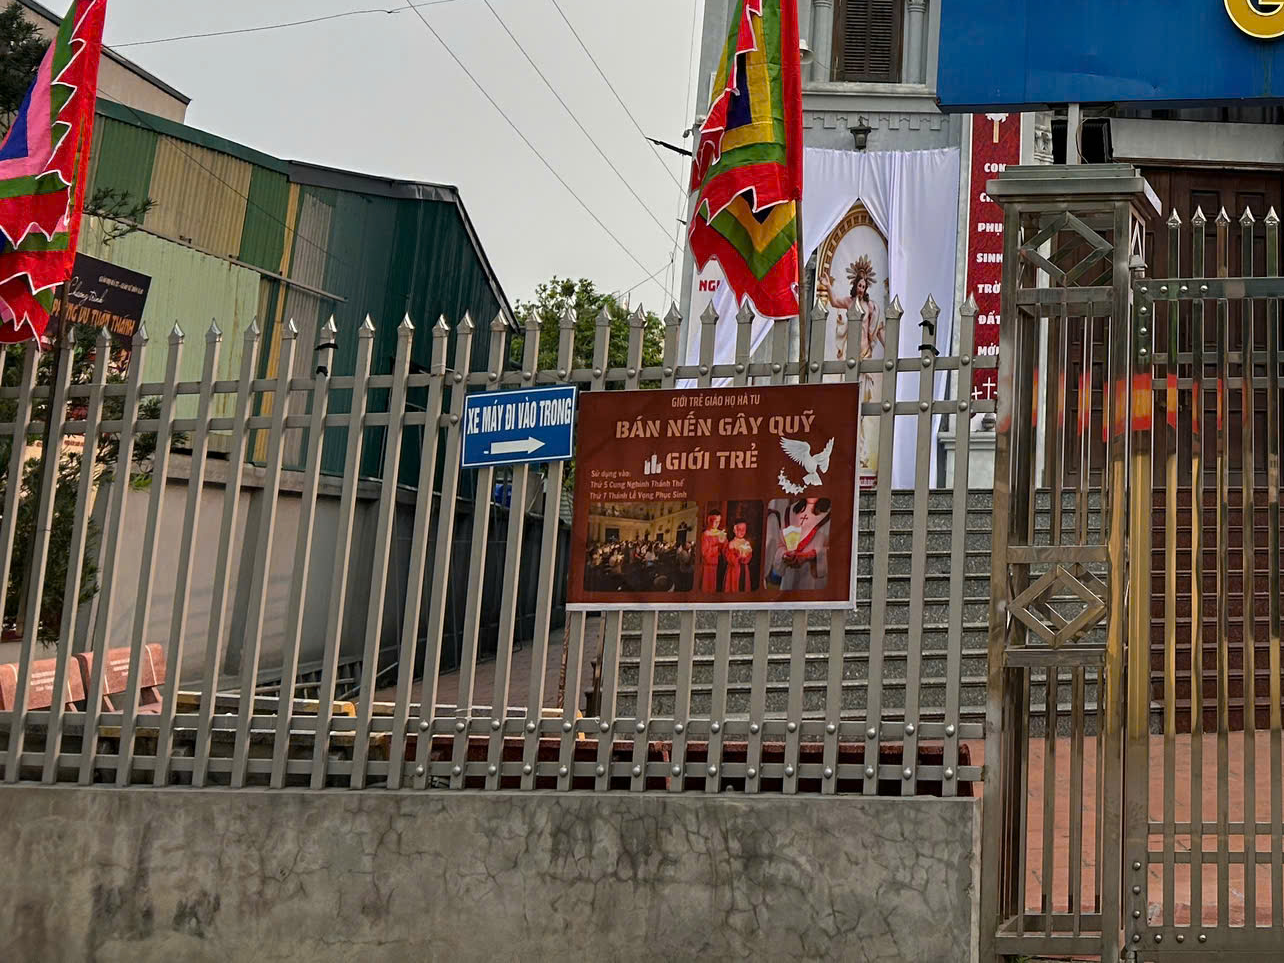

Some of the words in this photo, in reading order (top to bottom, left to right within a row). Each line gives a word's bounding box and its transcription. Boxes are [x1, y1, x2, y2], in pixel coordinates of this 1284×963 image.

[977, 223, 1004, 236] PHỤ
[704, 393, 723, 407] GIÁO
[737, 392, 748, 406] HÀ
[750, 394, 760, 405] TU
[467, 407, 481, 435] XE
[481, 399, 504, 433] MÁY
[504, 403, 516, 431] ĐI
[518, 396, 537, 430] VÀO
[539, 397, 572, 427] TRONG
[615, 415, 661, 439] BÁN
[666, 411, 712, 437] NẾN
[718, 412, 764, 437] GÂY
[769, 410, 816, 437] QUỸ
[665, 447, 711, 470] GIỚI
[716, 442, 759, 469] TRẺ
